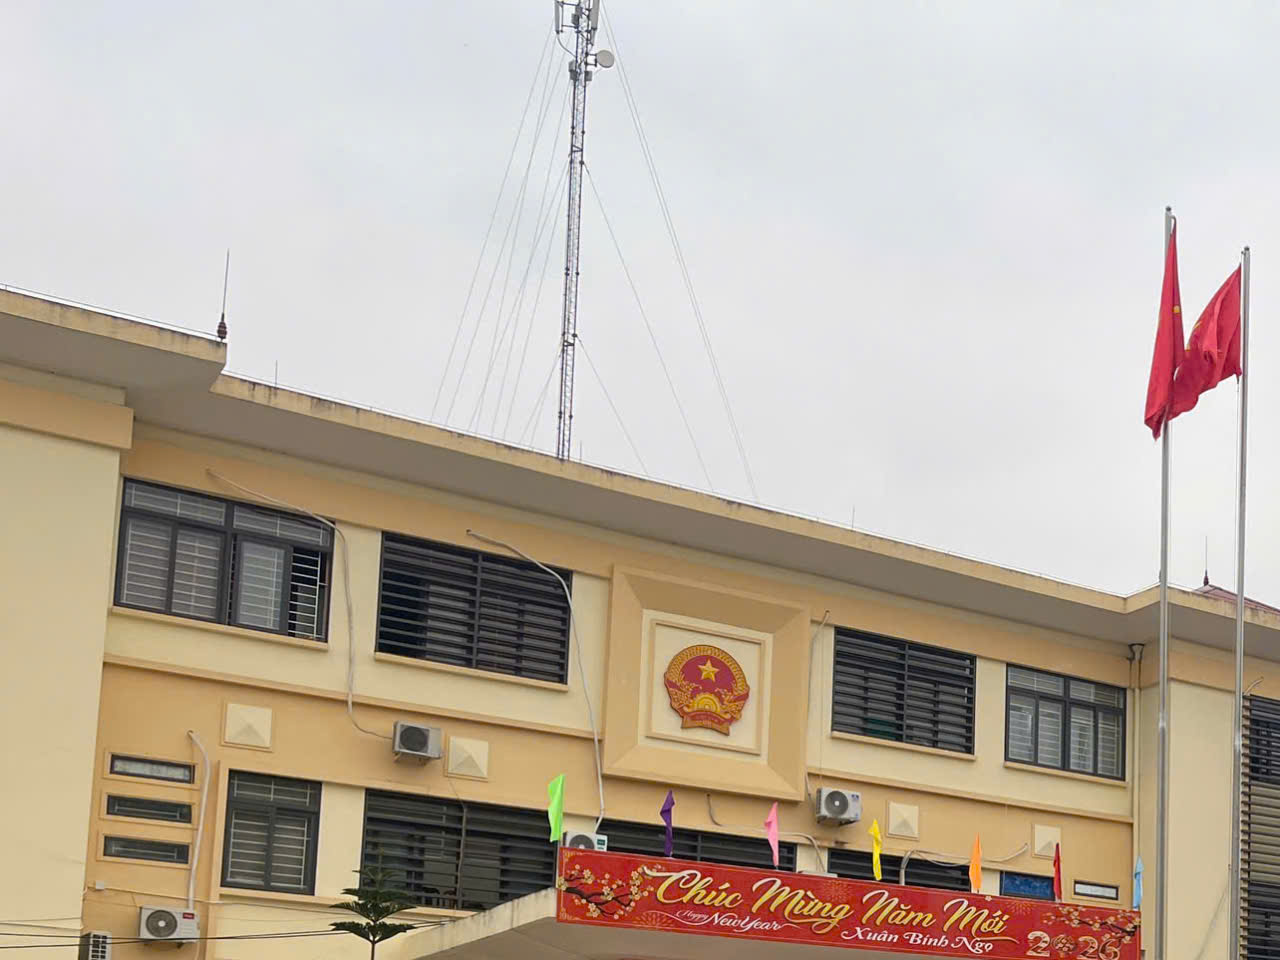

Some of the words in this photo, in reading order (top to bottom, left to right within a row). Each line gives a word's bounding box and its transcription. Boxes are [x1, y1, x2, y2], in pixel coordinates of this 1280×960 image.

[648, 869, 742, 908] Chúc
[752, 877, 855, 934] Mừng
[862, 889, 937, 928] Năm
[943, 898, 1018, 944] Mới
[841, 926, 899, 943] Xuân
[903, 930, 948, 947] Bính
[950, 936, 993, 954] Ngọ
